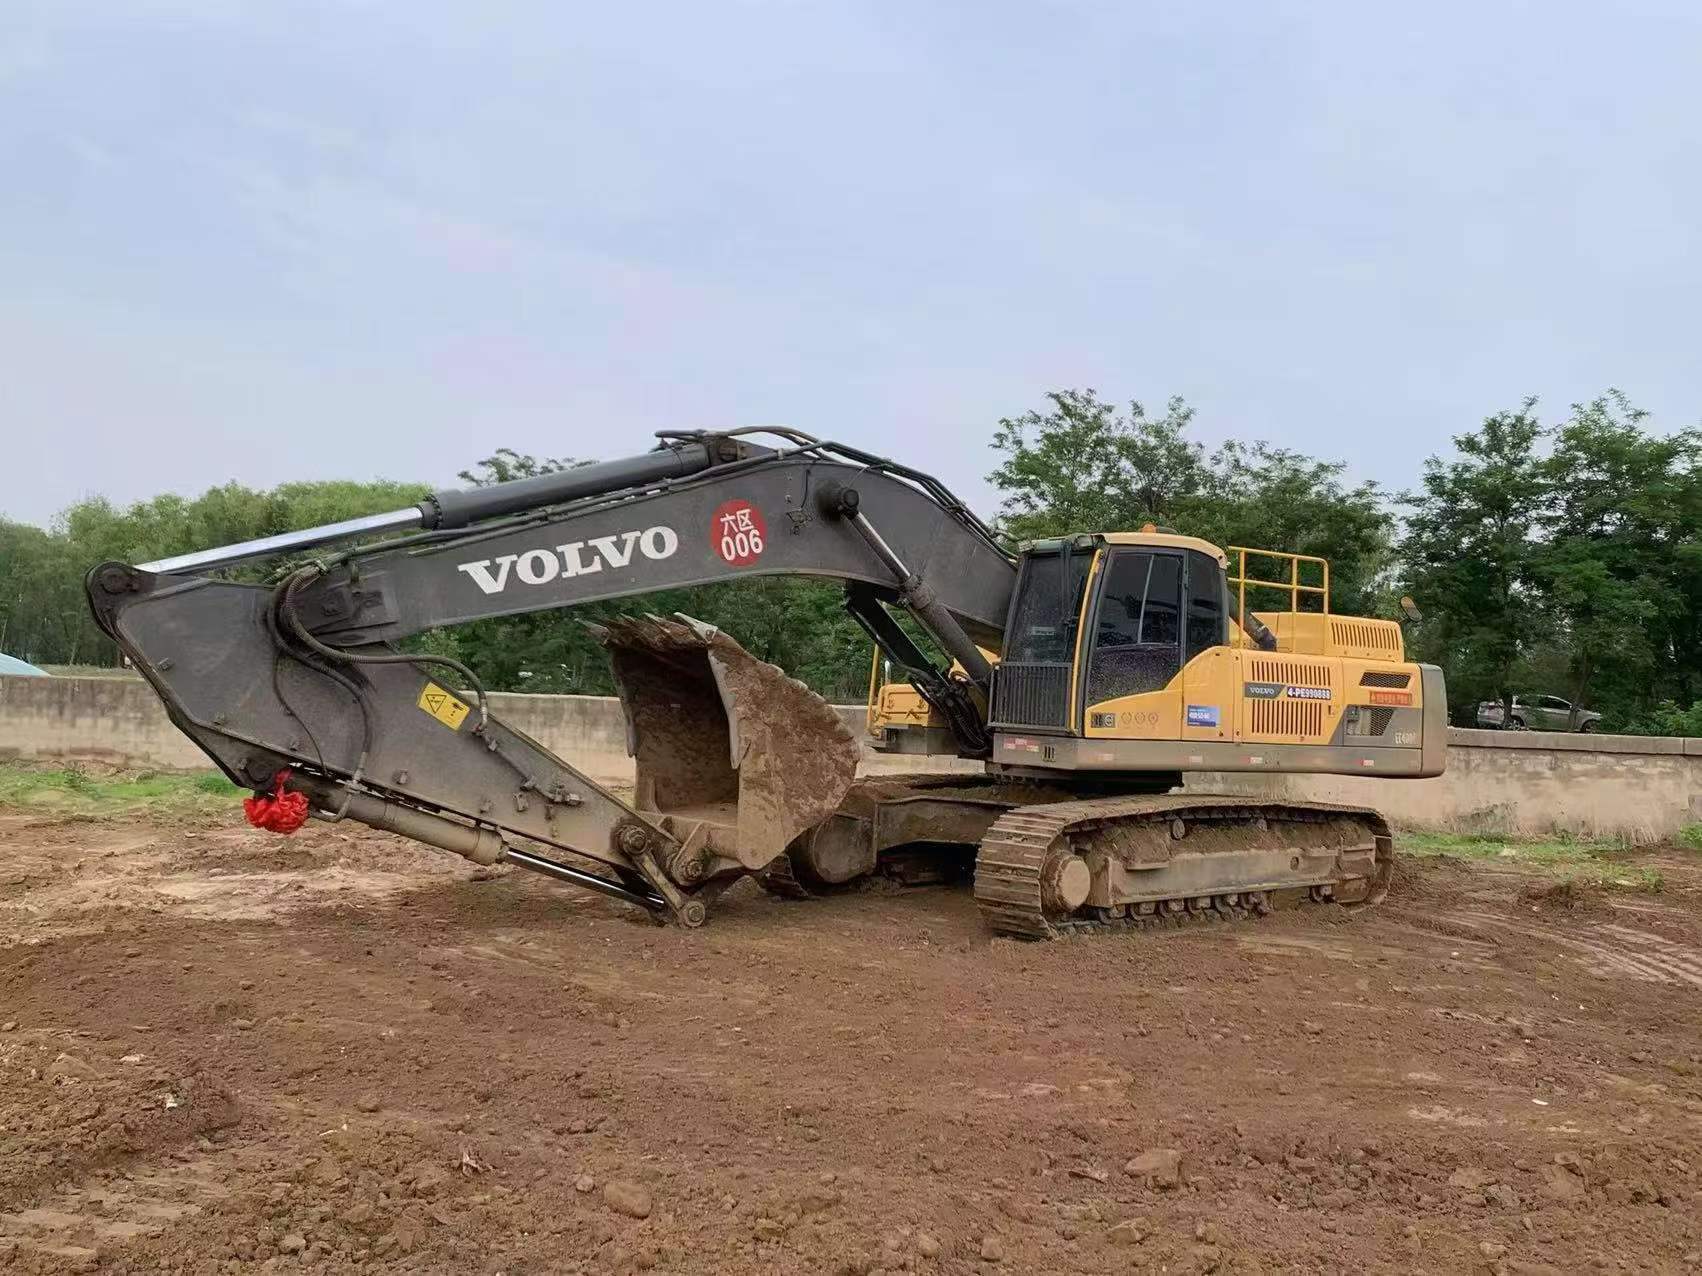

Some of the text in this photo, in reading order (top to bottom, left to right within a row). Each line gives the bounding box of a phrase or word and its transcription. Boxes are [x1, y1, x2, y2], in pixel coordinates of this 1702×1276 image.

[720, 508, 754, 535] 六区
[720, 529, 763, 561] 006
[457, 526, 678, 594] VOLVO
[1249, 687, 1275, 695] VOLVO
